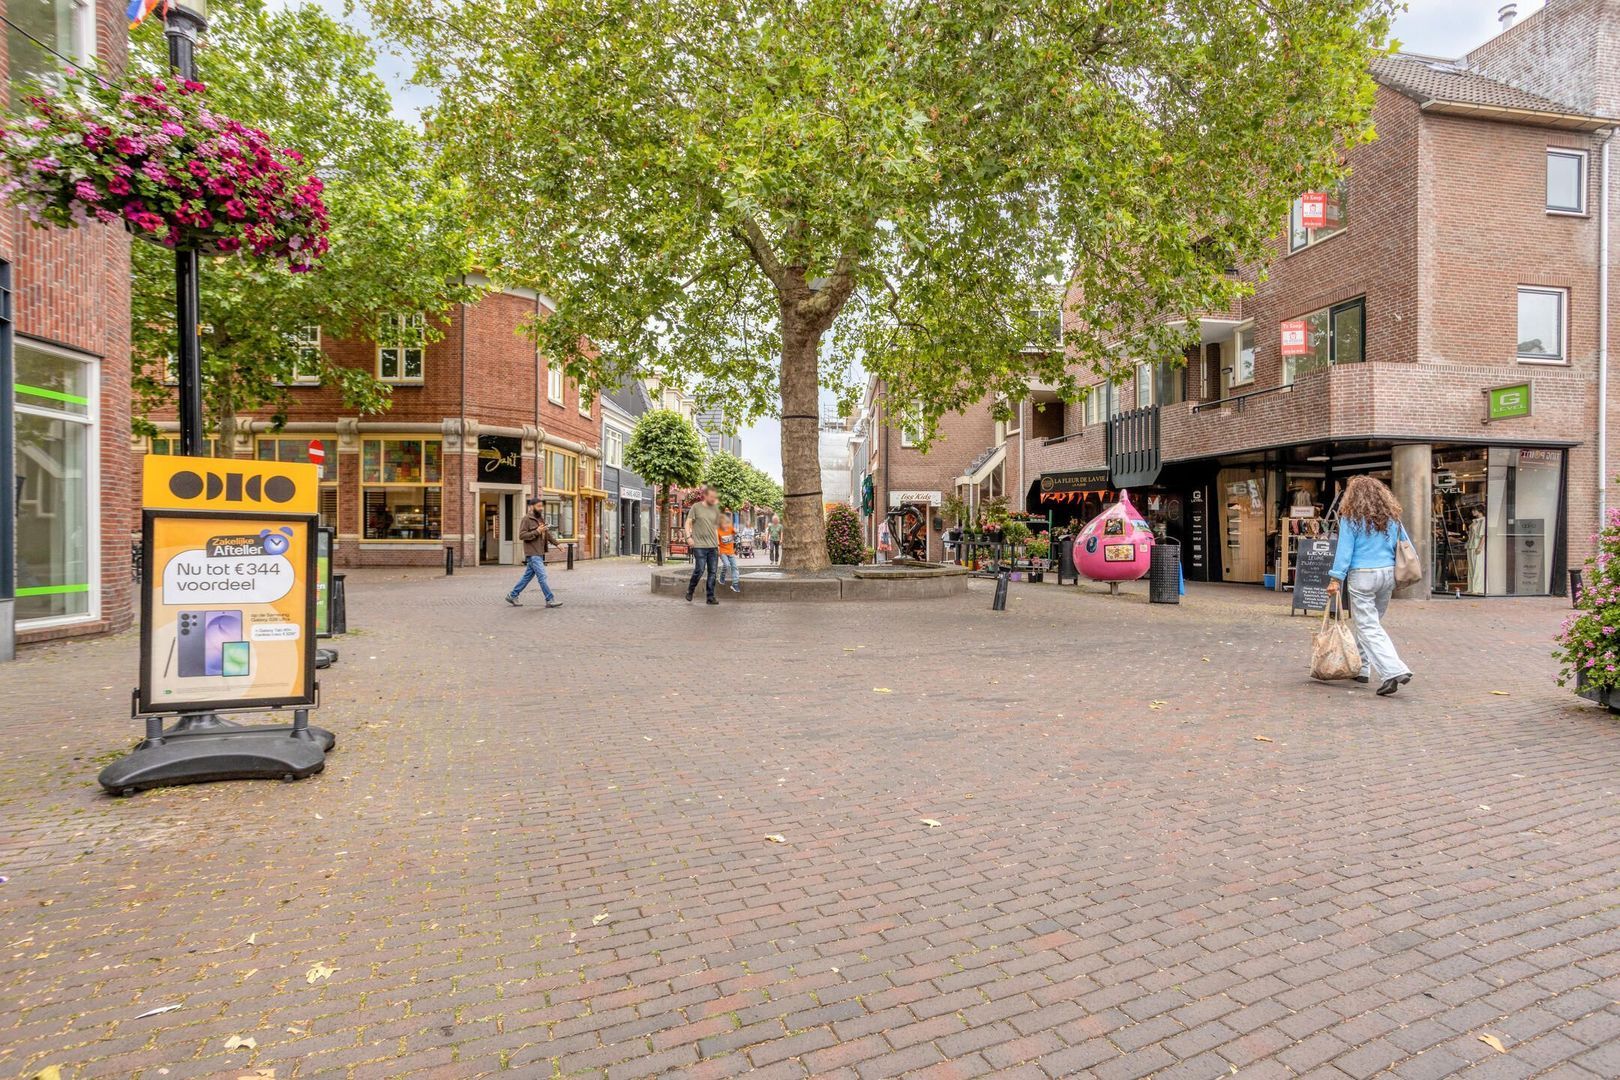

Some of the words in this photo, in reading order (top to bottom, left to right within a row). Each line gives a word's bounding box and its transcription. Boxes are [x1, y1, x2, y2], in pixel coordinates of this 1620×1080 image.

[1500, 392, 1520, 406] G
[1193, 491, 1201, 499] G
[212, 537, 255, 546] Zakelijke
[1313, 541, 1330, 551] G
[213, 545, 263, 556] Afteller
[177, 562, 201, 576] Nu
[206, 564, 230, 576] tot
[177, 578, 255, 591] voordeel
